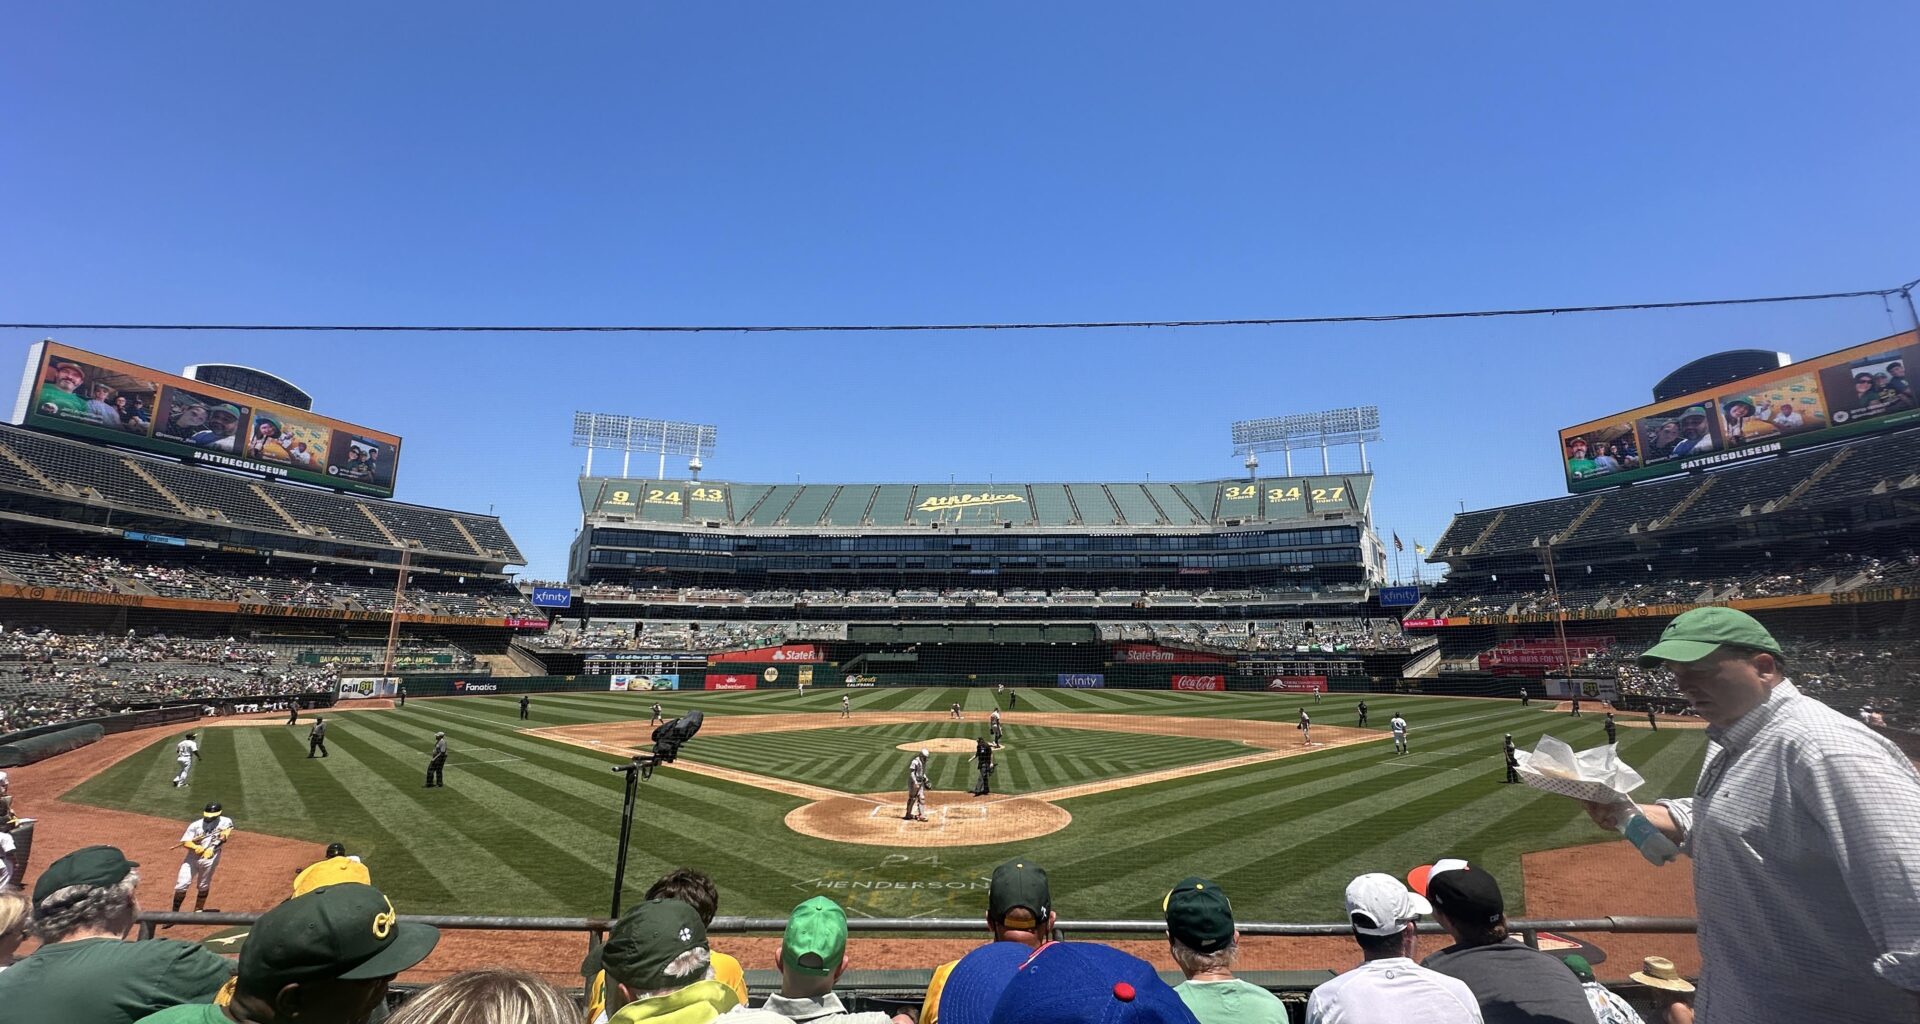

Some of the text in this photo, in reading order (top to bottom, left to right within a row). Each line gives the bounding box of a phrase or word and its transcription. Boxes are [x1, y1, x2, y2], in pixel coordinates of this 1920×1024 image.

[1681, 443, 1781, 470] #ATTHECOLISEUM
[194, 452, 288, 477] #ATTHECOLISEUM
[612, 491, 630, 502] 9
[645, 490, 680, 502] 24
[692, 488, 722, 499] 43
[1225, 486, 1256, 498] 34
[1268, 487, 1301, 500] 34
[1311, 487, 1344, 500] 27
[916, 493, 1026, 511] Athletics
[535, 592, 568, 603] xfinity
[1383, 590, 1416, 602] xfinity
[238, 603, 257, 613] SEE
[259, 604, 287, 615] YOUR
[290, 606, 334, 618] PHOTOS
[333, 609, 346, 618] ON
[349, 610, 367, 619] THE
[1469, 616, 1485, 625] SEE
[1485, 614, 1508, 624] YOUR
[1513, 611, 1548, 624] PHOTOS
[1565, 610, 1585, 620] THE
[1585, 608, 1617, 619] BOARD
[1128, 650, 1174, 661] StateFarm
[341, 680, 374, 693] Call 811
[465, 683, 497, 691] Fanatics
[1065, 675, 1097, 688] xfinity
[1583, 682, 1598, 690] 811
[879, 854, 944, 869] 24
[815, 881, 990, 889] HENDERSON
